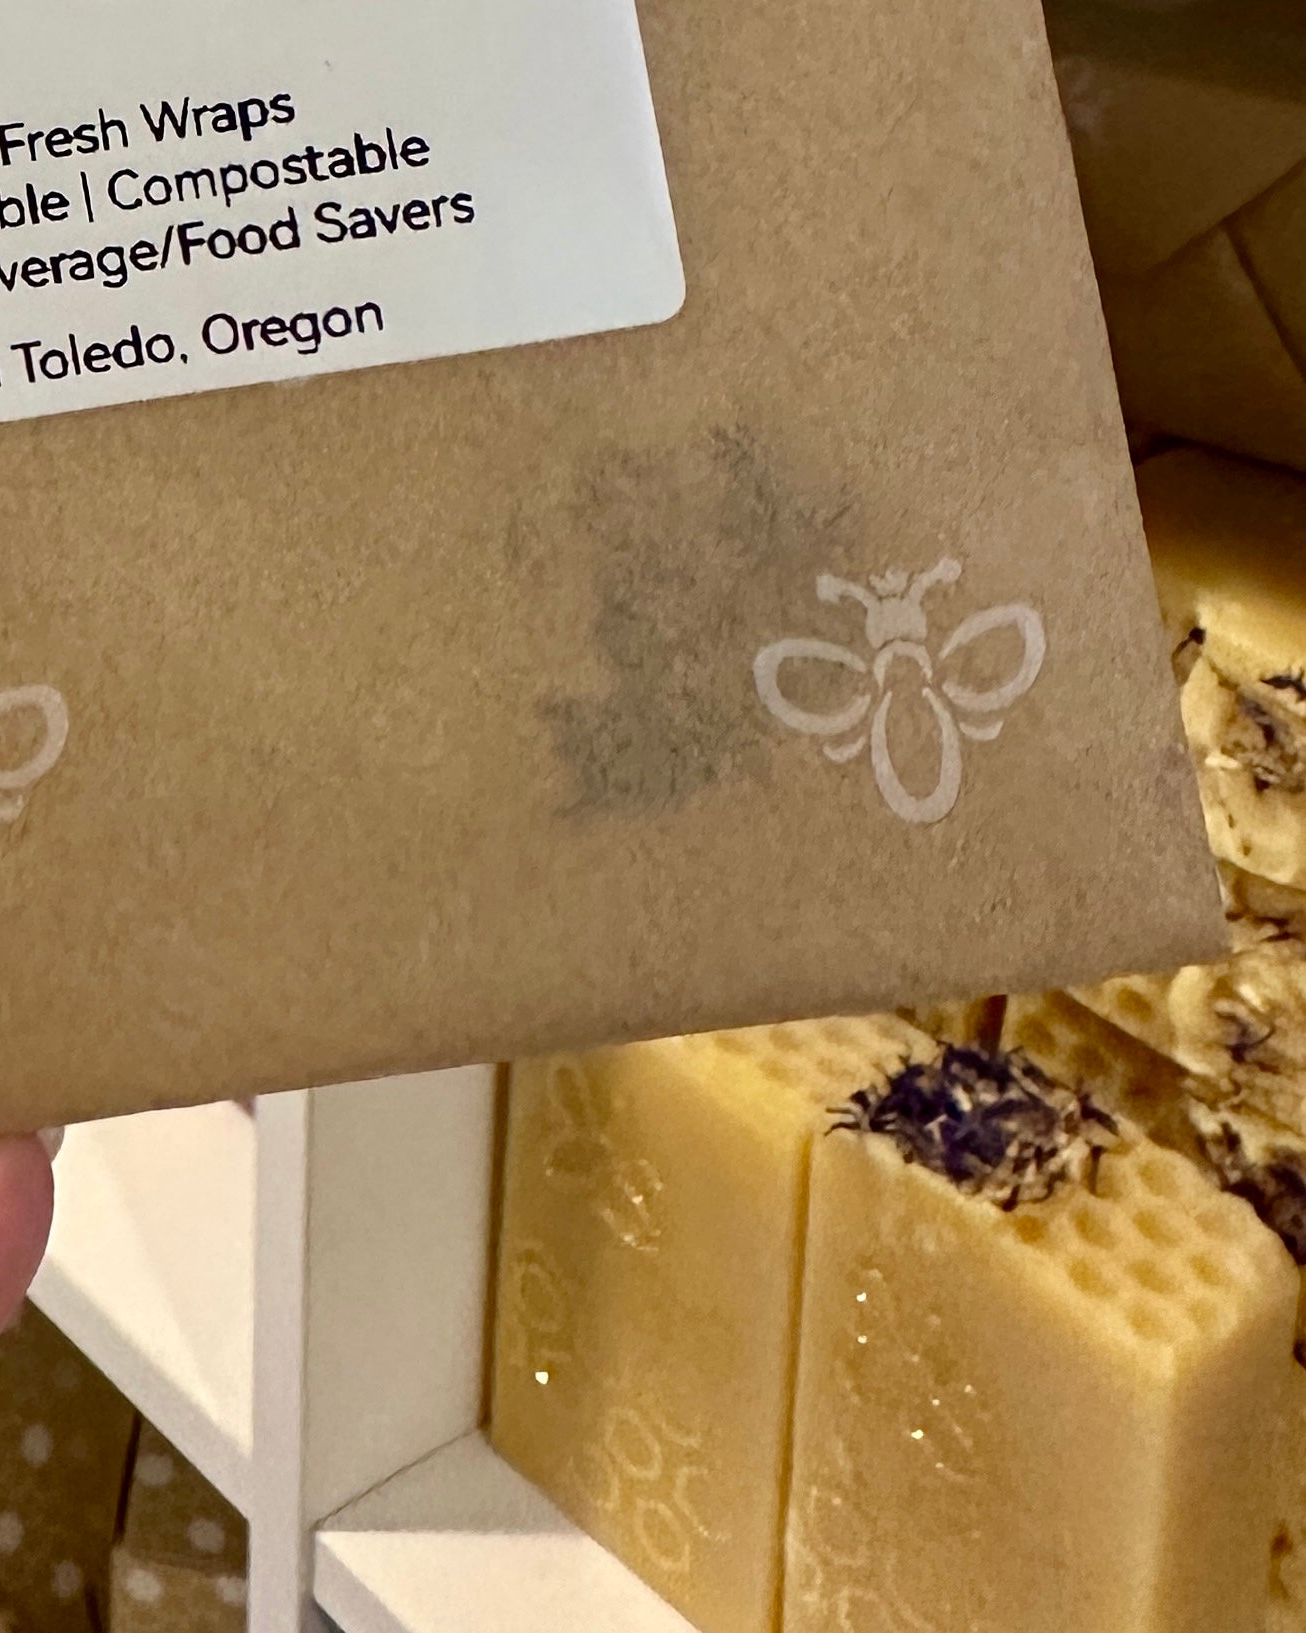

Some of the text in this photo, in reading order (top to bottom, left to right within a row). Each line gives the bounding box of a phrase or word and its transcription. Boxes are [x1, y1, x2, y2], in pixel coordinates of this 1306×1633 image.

[139, 92, 297, 143] Wraps
[106, 126, 432, 212] Compostable
[312, 191, 476, 245] Savers
[200, 300, 385, 356] Oregon
